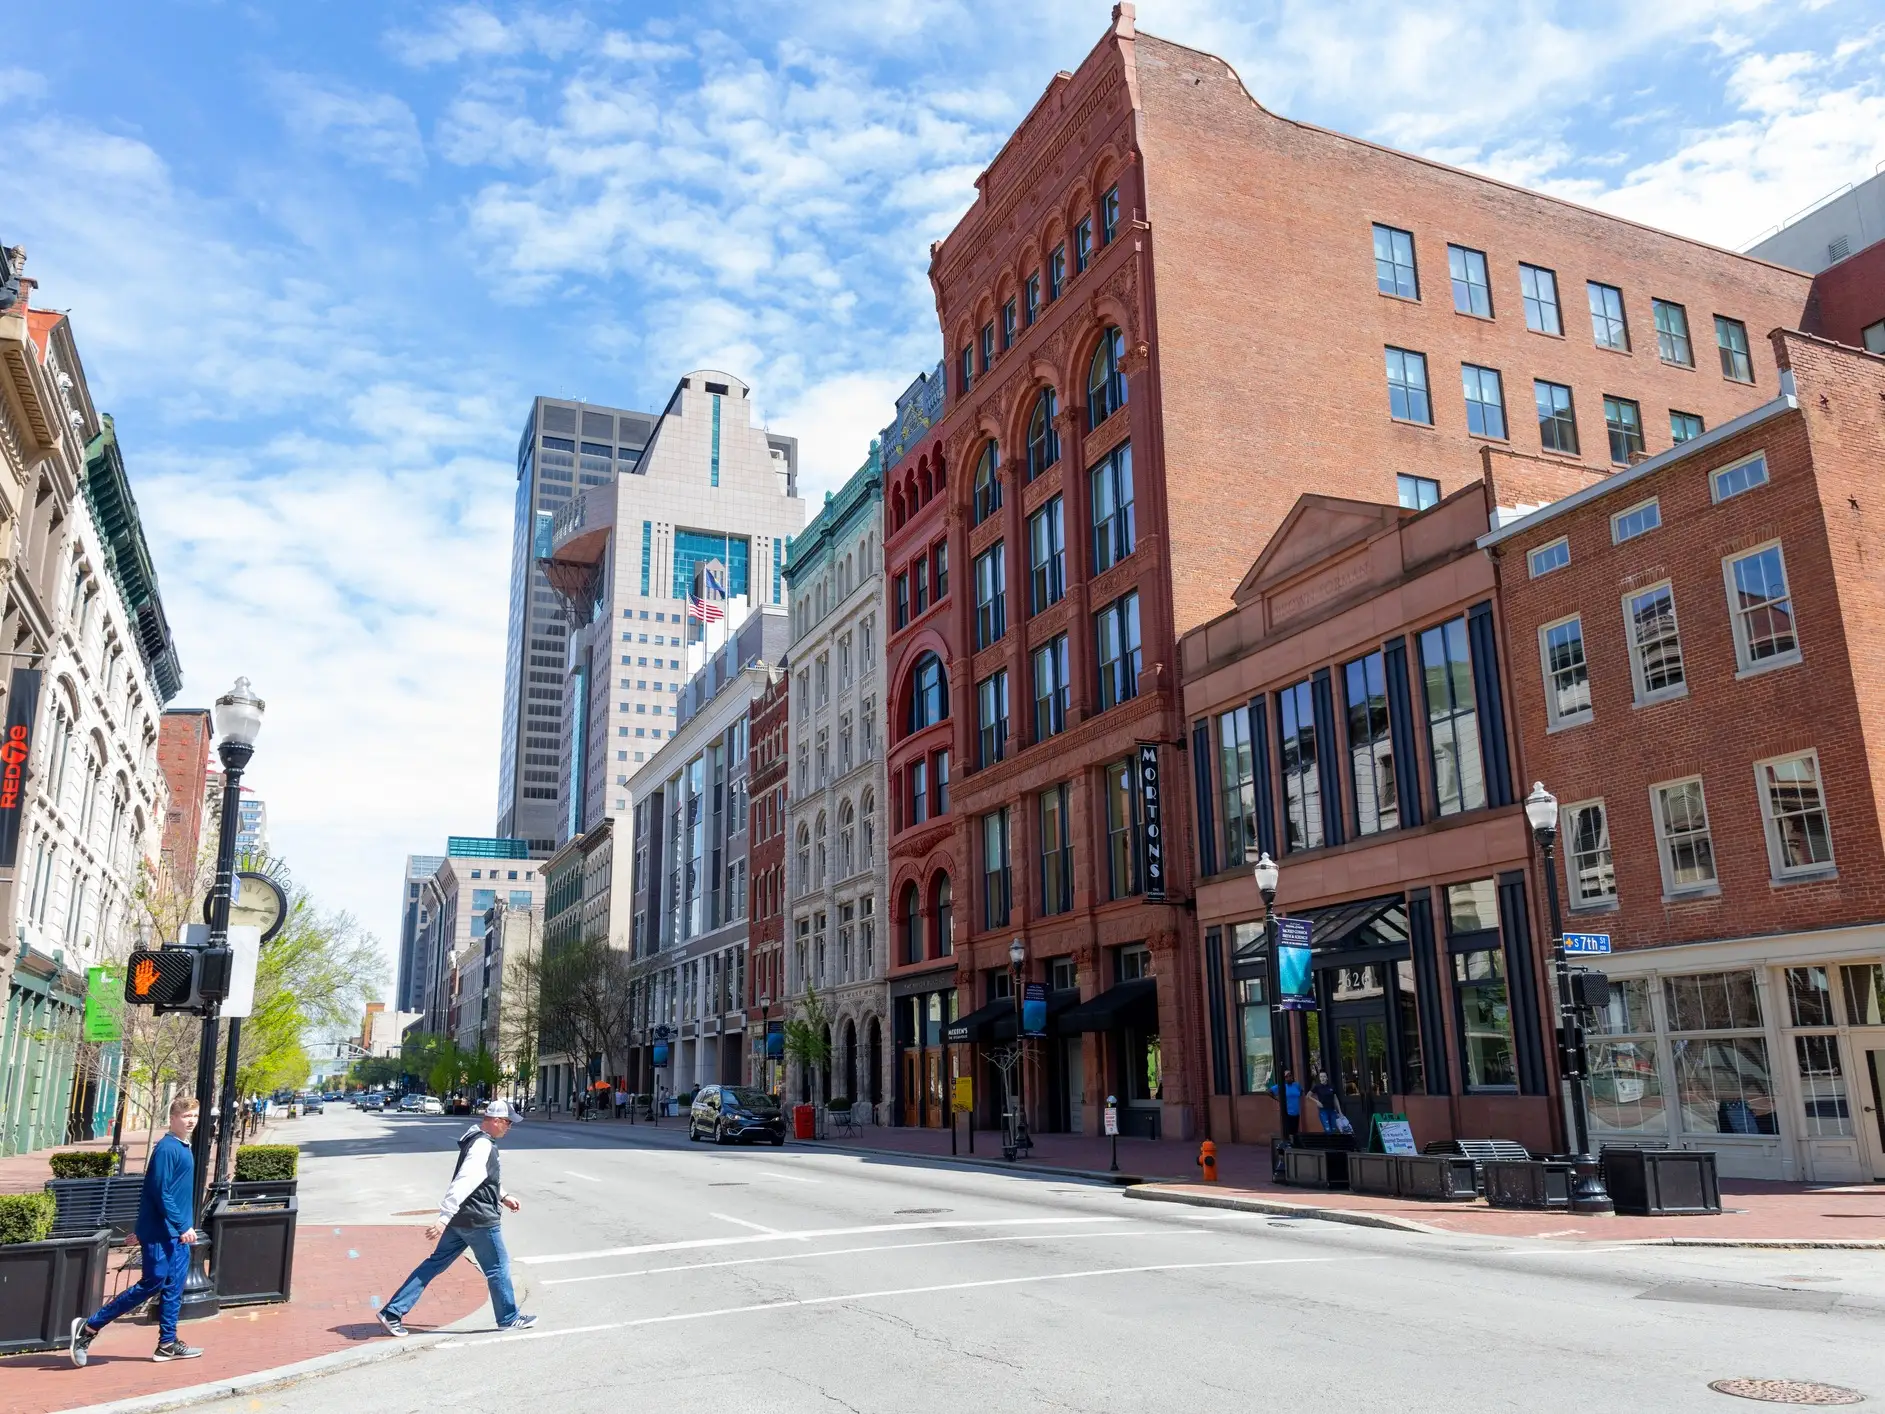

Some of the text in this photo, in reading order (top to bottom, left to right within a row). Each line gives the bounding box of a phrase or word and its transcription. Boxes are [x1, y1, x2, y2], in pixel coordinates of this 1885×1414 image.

[1574, 938, 1580, 948] S
[1580, 936, 1598, 951] 7th
[1346, 971, 1368, 988] 626
